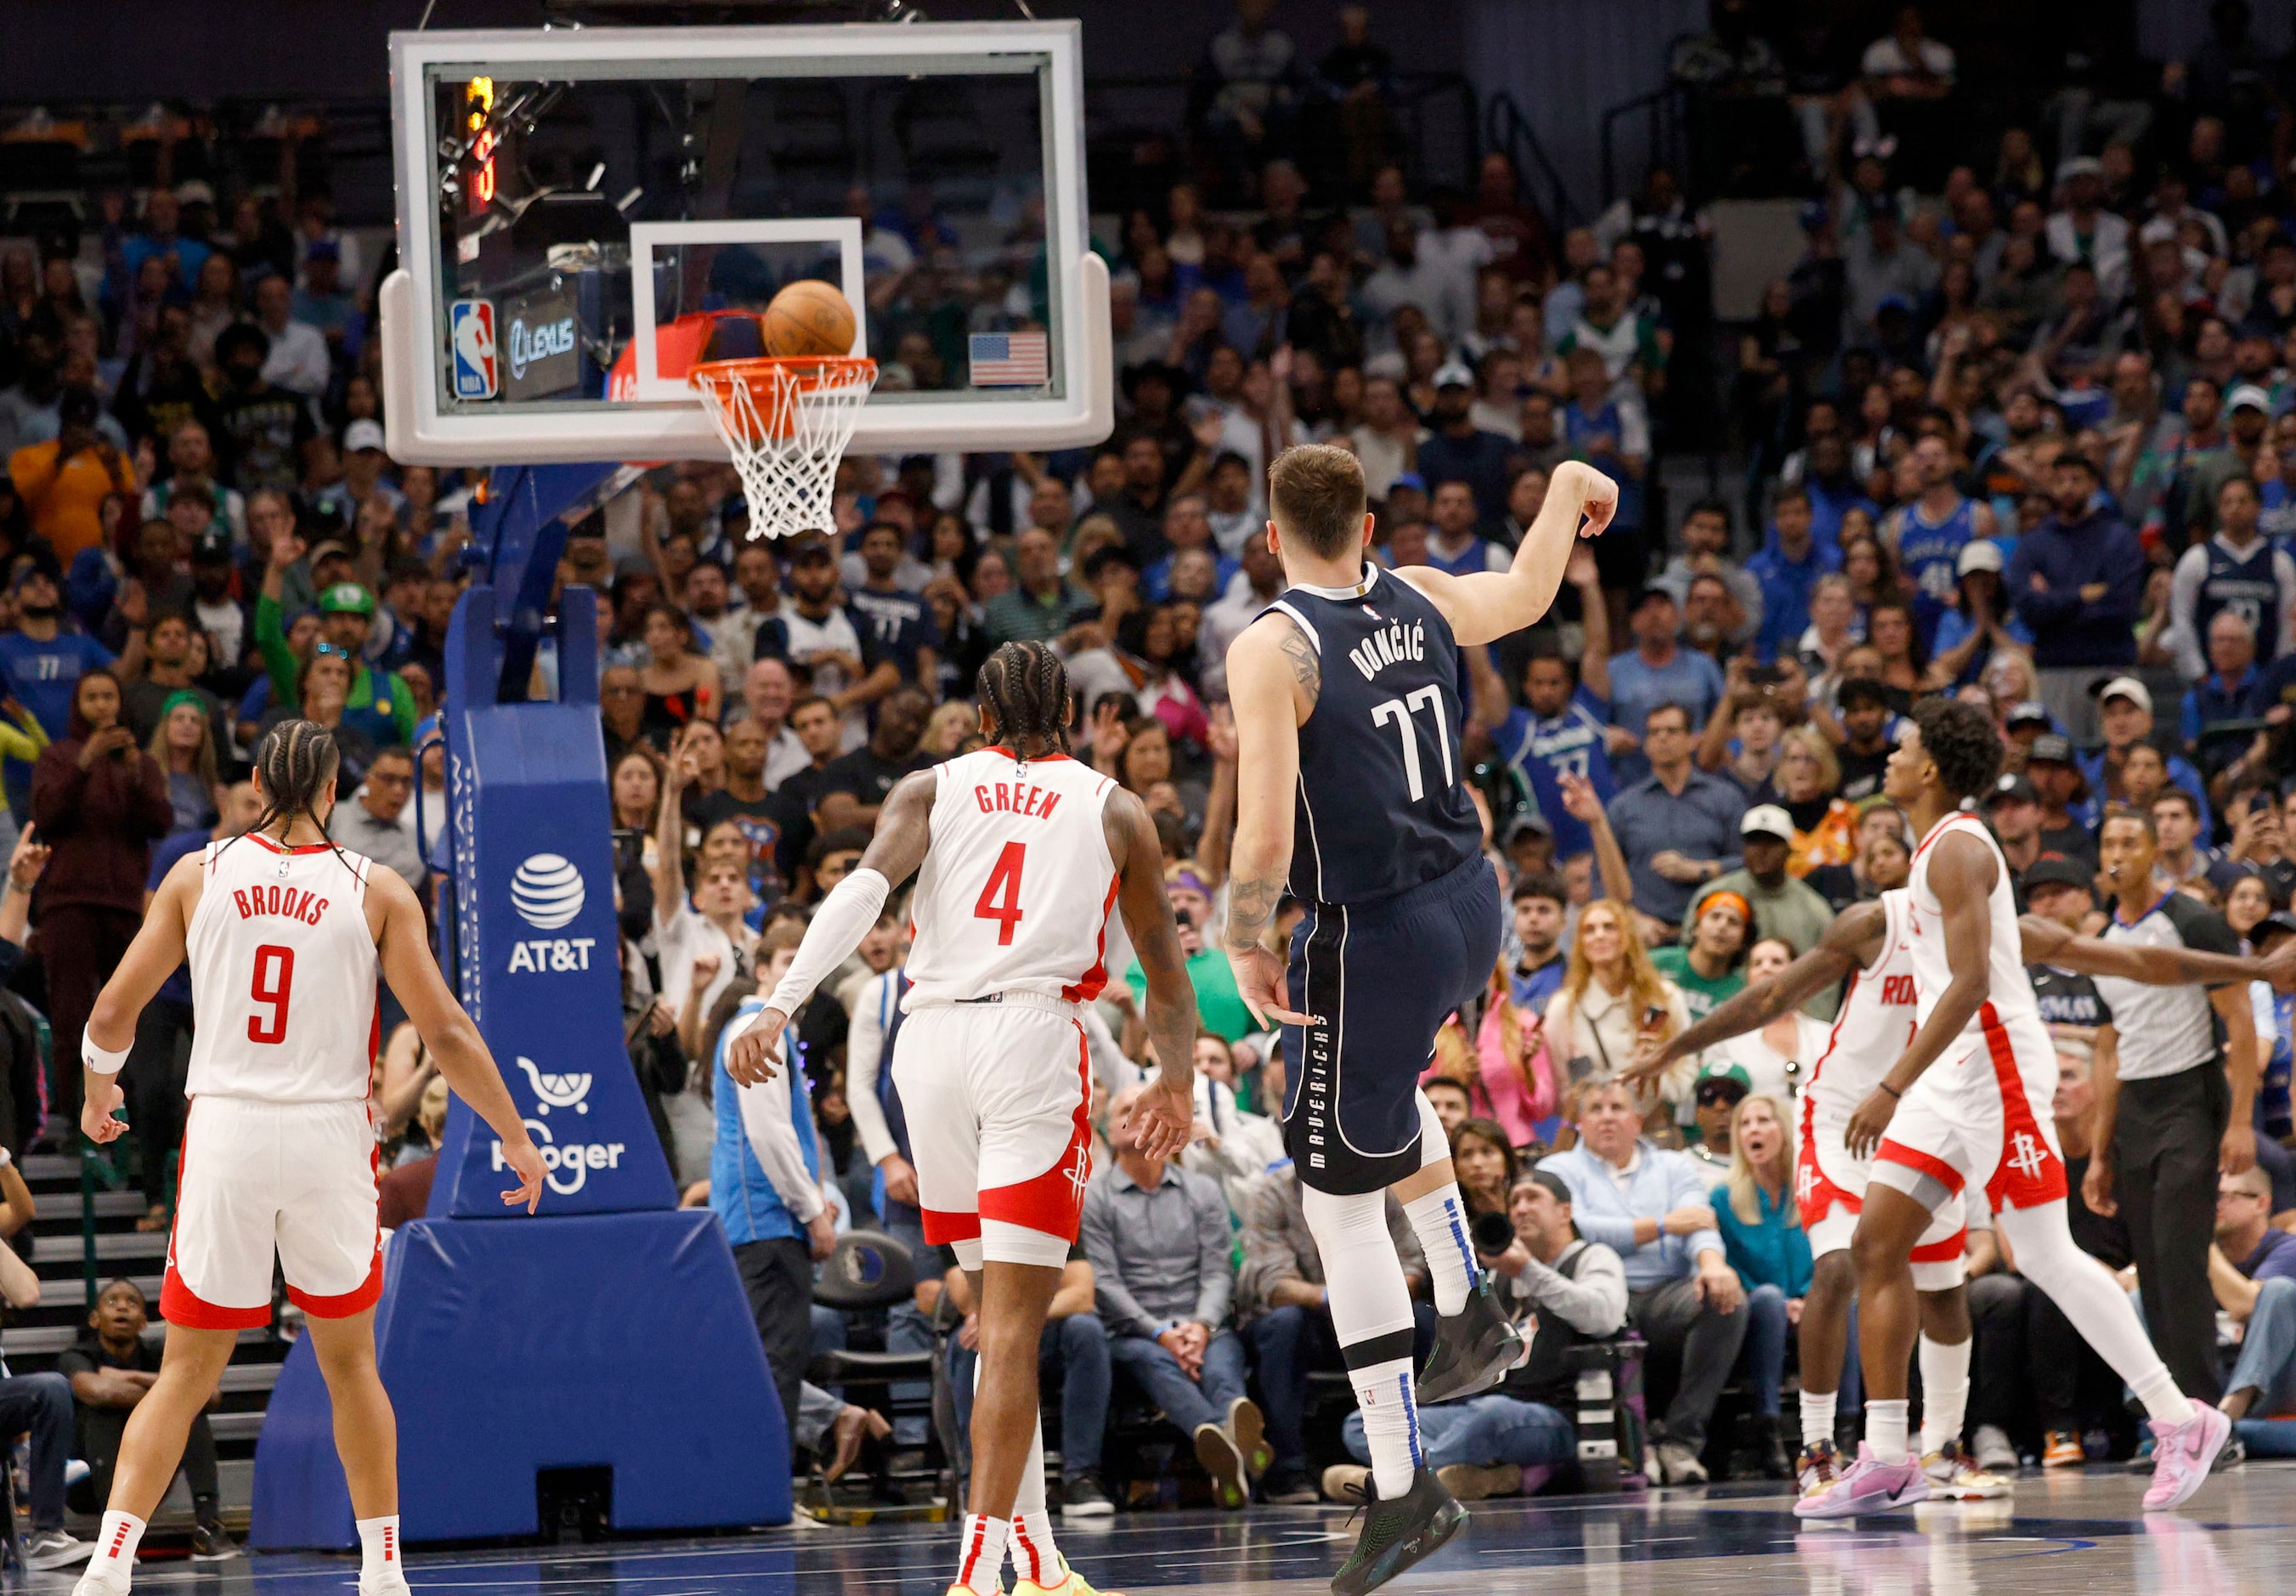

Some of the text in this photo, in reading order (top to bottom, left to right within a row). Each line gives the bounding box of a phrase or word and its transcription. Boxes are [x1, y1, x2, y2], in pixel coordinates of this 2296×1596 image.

[526, 318, 575, 362] LEXUS
[461, 376, 482, 393] NBA
[1349, 617, 1424, 682] DONČIĆ
[1371, 683, 1453, 803] 77
[975, 782, 1061, 820] GREEN
[233, 885, 330, 926] BROOKS
[451, 753, 472, 1016] HOCTAW
[974, 840, 1026, 945] 4
[507, 937, 596, 974] AT&T
[247, 944, 295, 1044] 9
[490, 1118, 625, 1196] Koger
